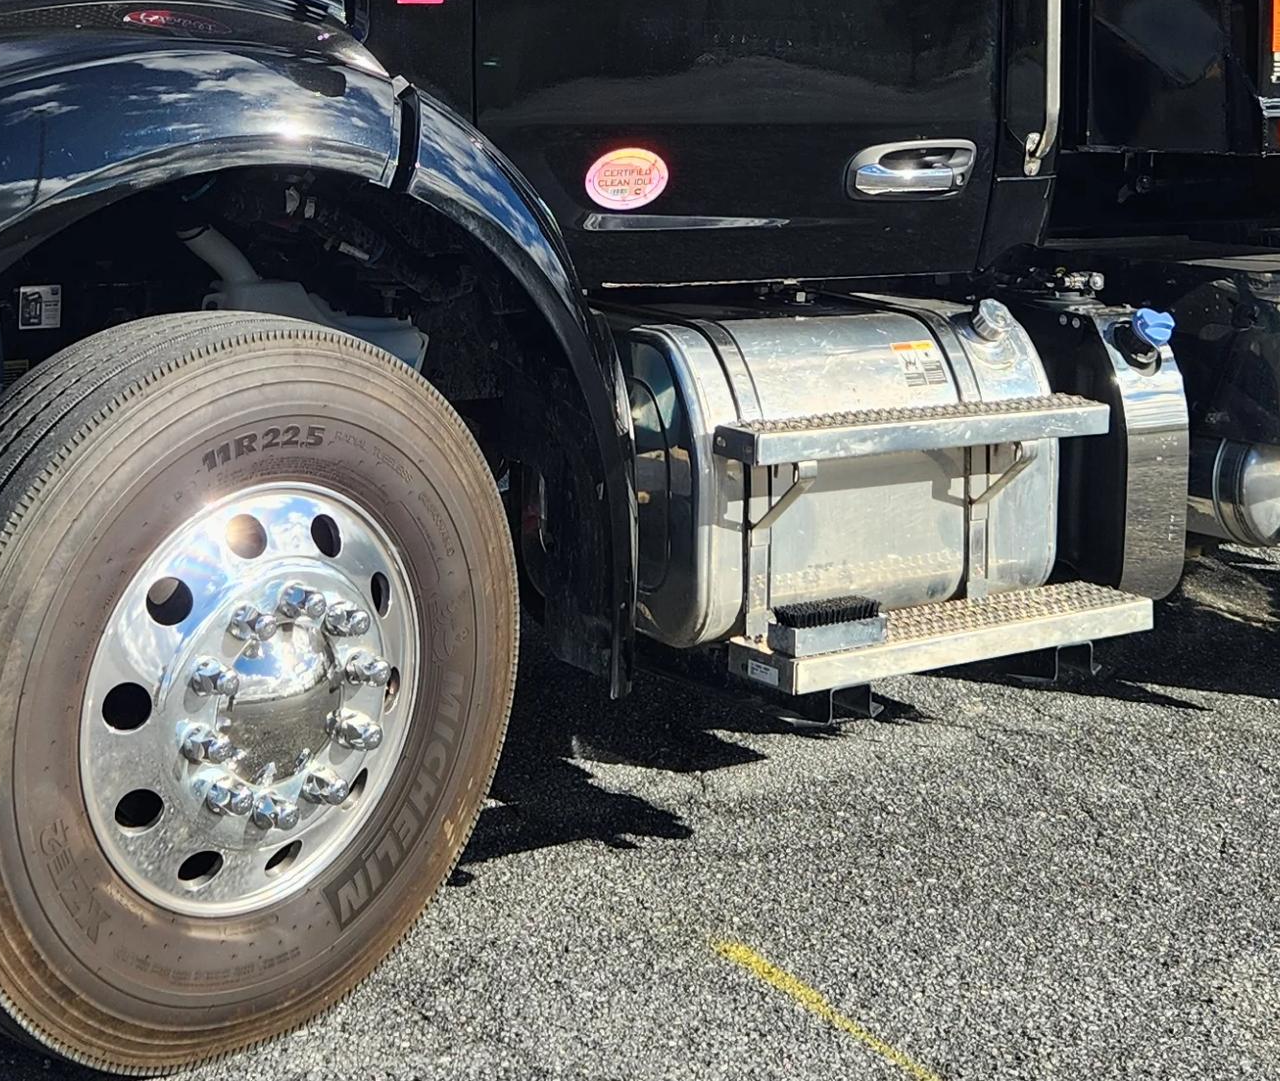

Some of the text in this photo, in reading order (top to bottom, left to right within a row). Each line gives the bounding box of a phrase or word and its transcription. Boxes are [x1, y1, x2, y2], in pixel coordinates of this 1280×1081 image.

[603, 167, 652, 177] CERTIFIED
[598, 179, 630, 187] CLEAN
[338, 670, 466, 923] MICHELIN
